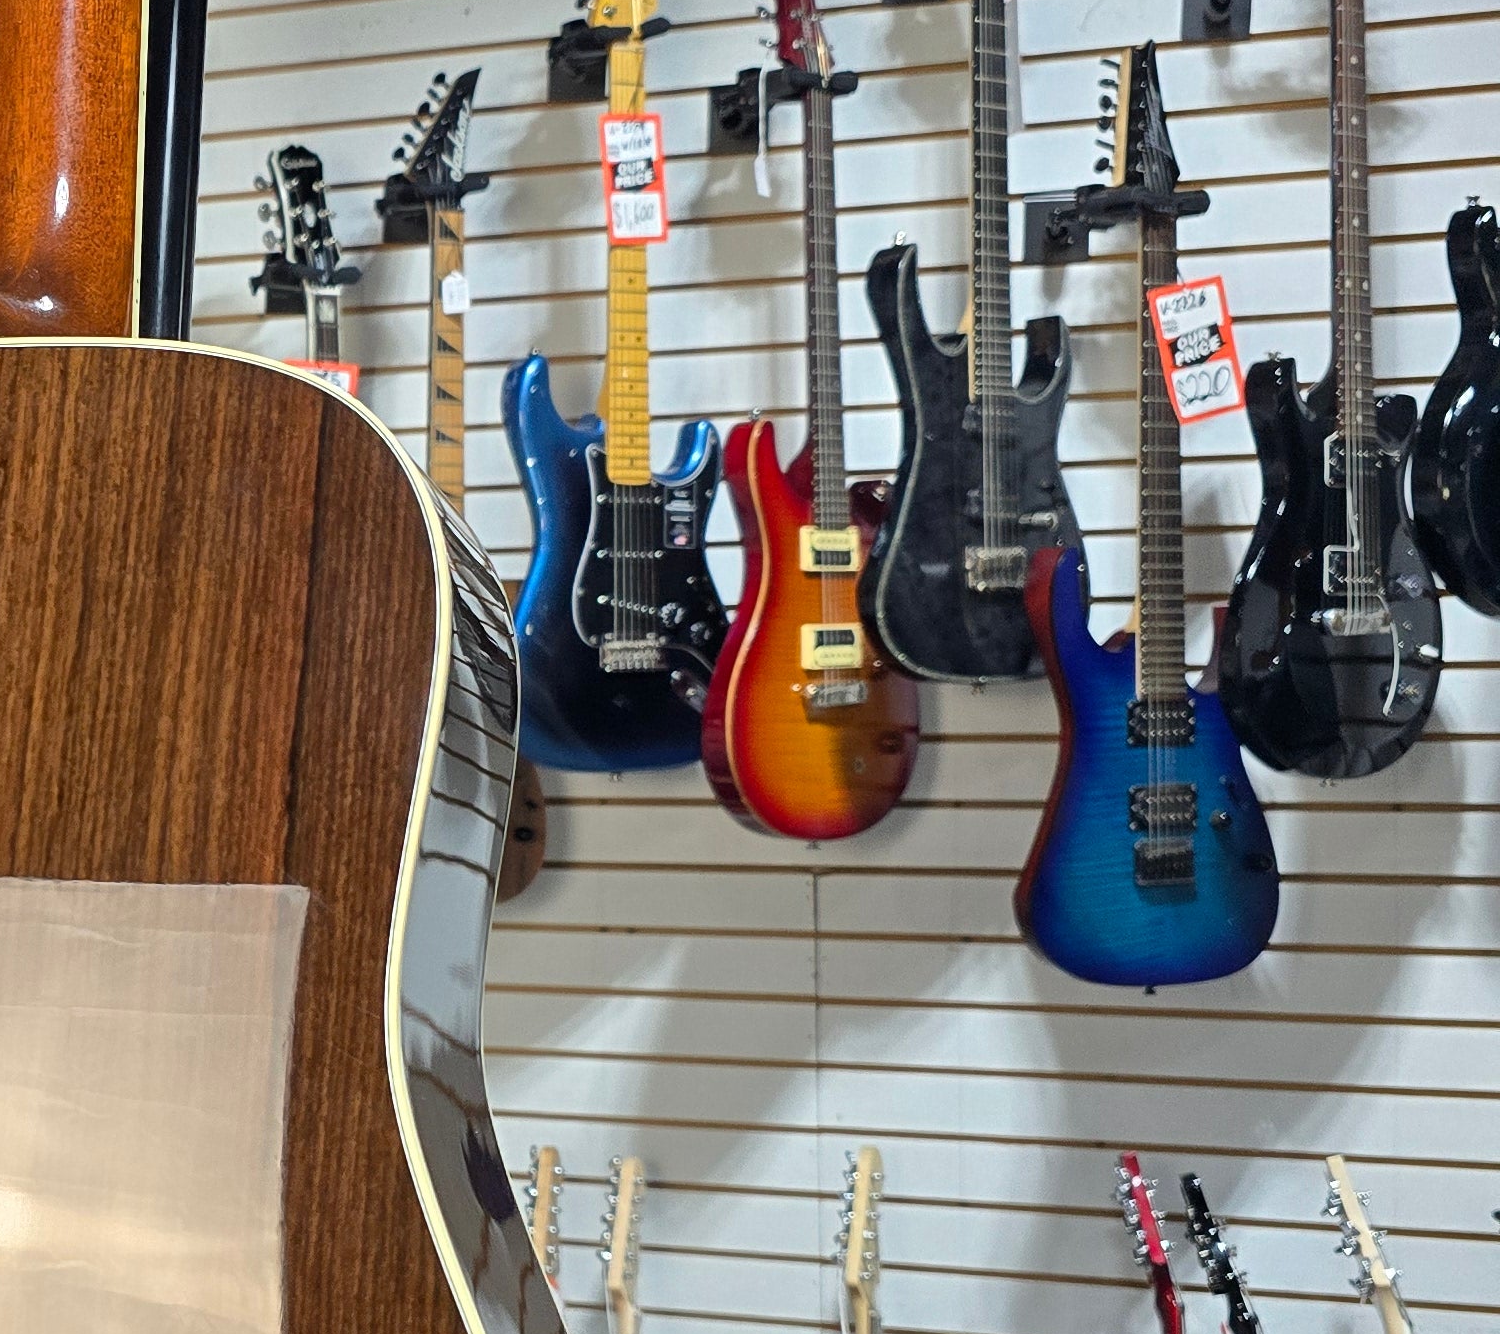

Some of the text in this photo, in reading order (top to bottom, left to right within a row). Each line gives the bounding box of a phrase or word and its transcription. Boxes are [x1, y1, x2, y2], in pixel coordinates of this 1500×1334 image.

[1174, 334, 1222, 367] PRICE
[1176, 327, 1211, 350] OUR
[1176, 365, 1231, 407] $220
